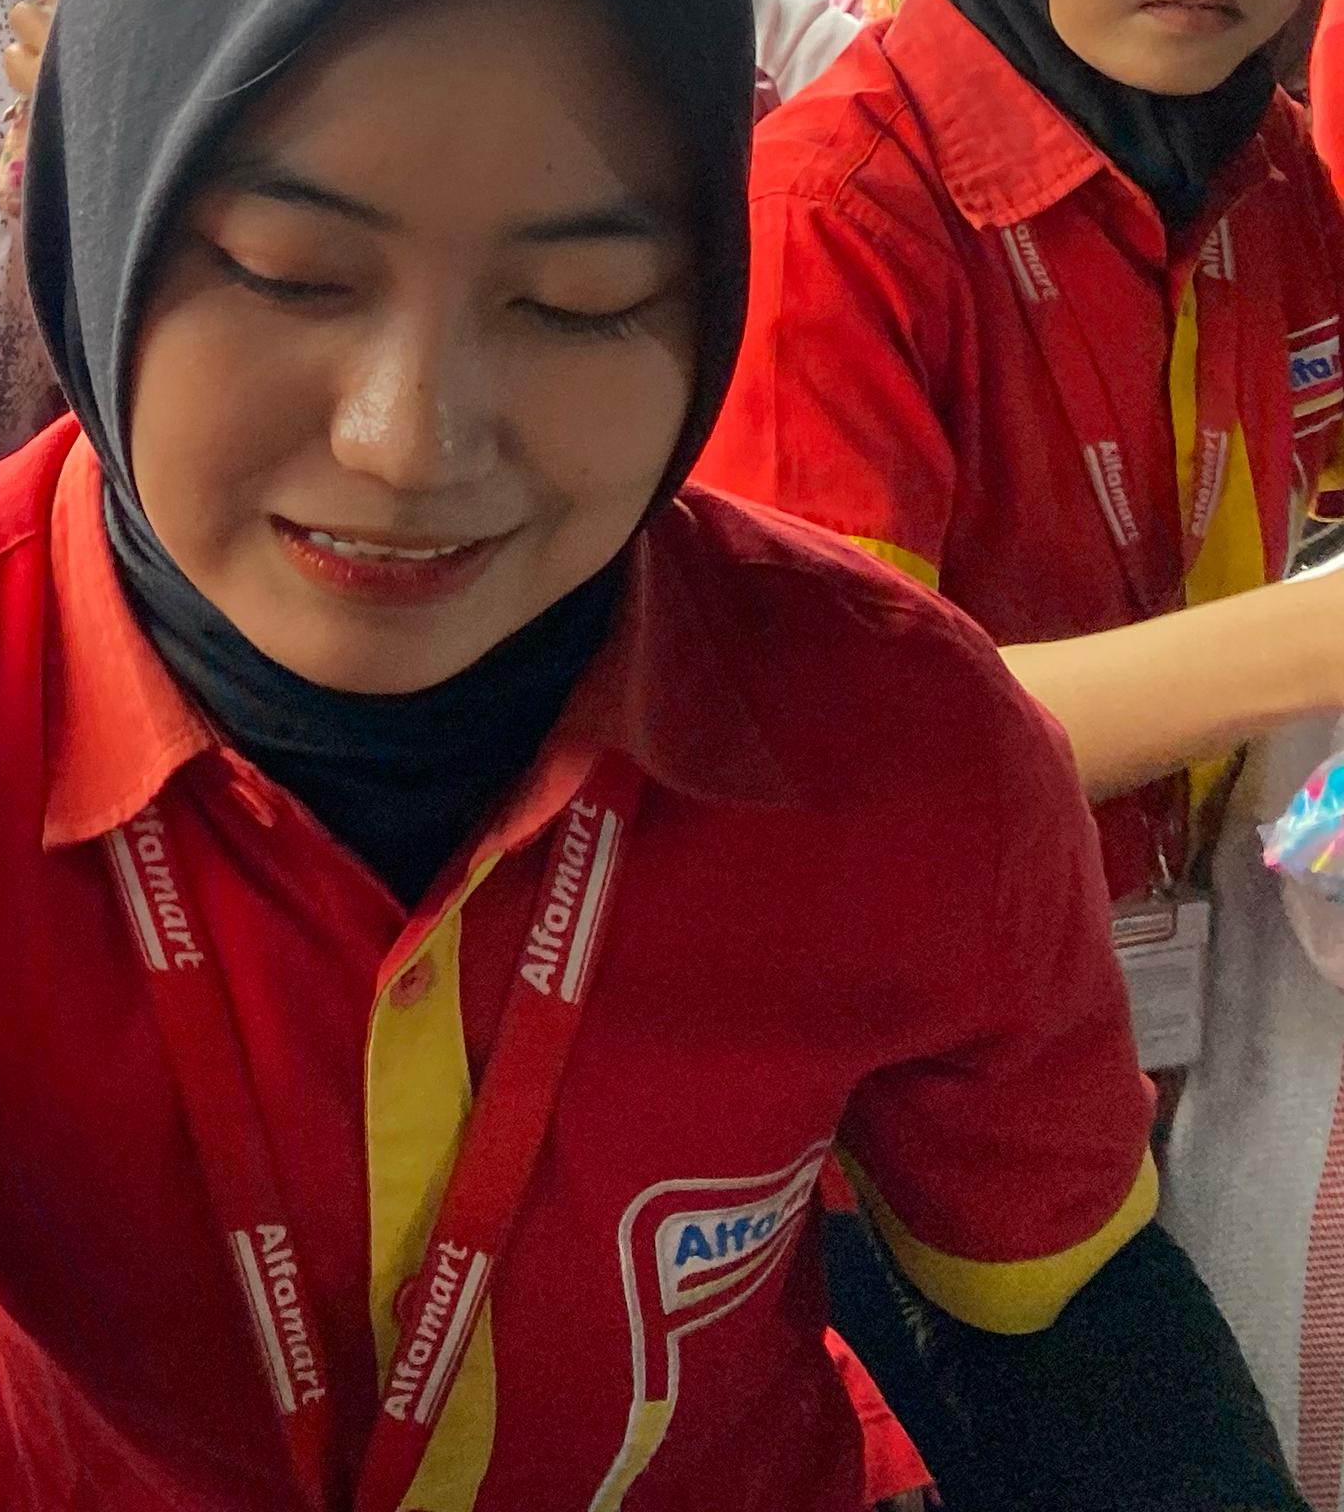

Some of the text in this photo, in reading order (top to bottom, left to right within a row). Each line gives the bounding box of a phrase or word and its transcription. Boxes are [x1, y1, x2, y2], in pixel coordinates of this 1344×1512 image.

[133, 806, 204, 971] famart
[520, 797, 599, 996] Alfamart
[255, 1224, 326, 1406] Alfamart
[383, 1240, 468, 1422] Alfamart
